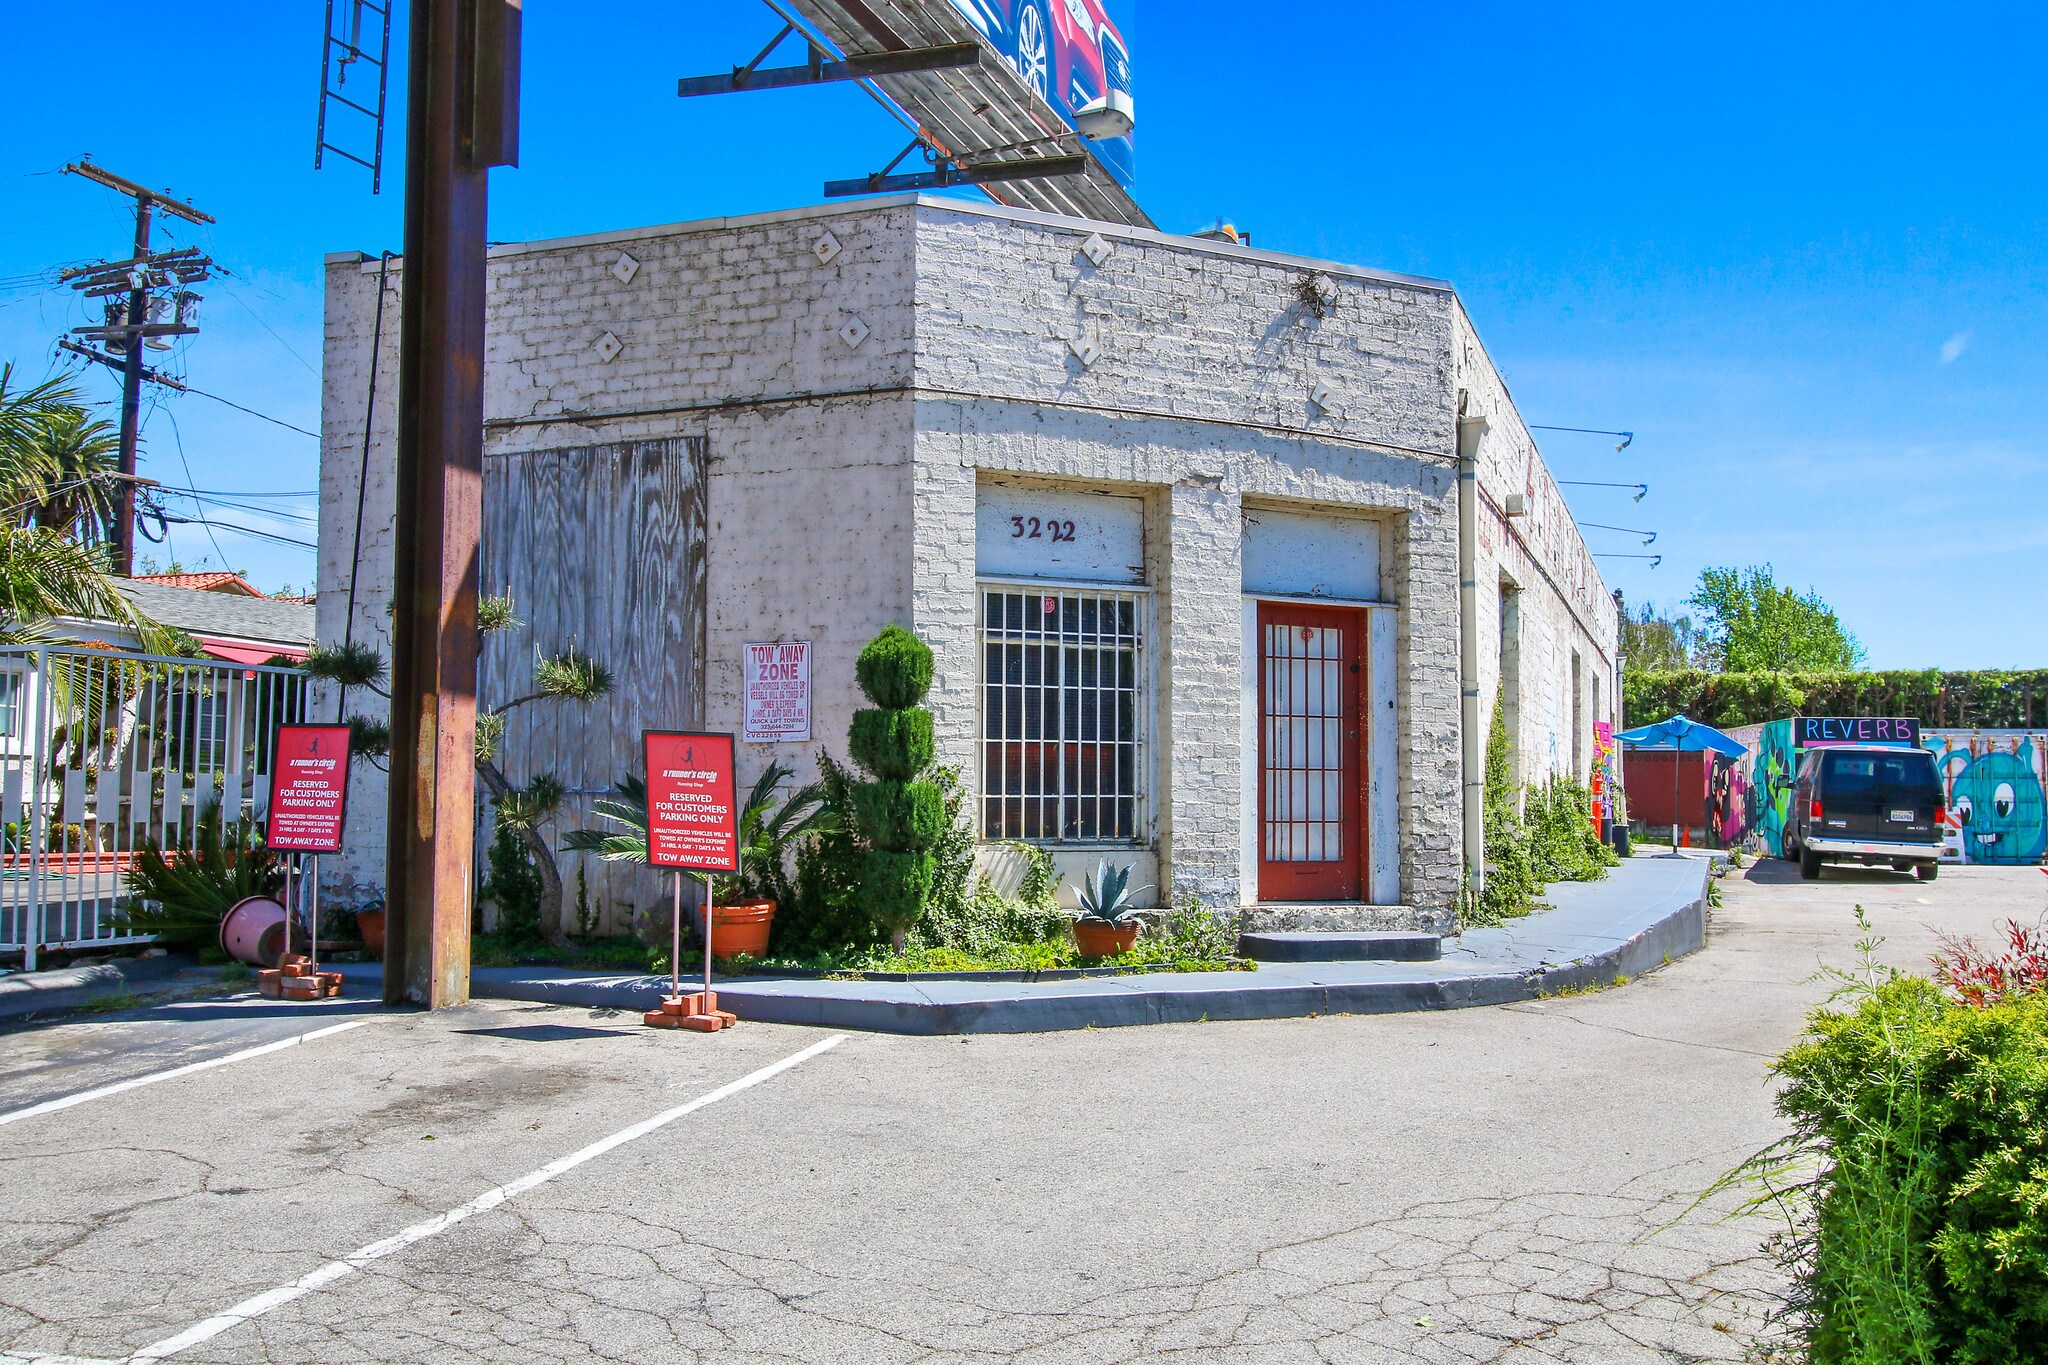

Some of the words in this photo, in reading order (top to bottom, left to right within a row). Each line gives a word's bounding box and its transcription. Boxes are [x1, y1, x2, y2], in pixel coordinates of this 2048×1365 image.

[1011, 516, 1076, 542] 3222
[751, 646, 774, 664] TOW
[780, 645, 805, 663] AWAY
[759, 663, 798, 681] ZONE
[751, 682, 779, 690] UNAUTHORIZED
[781, 681, 798, 690] VEHICLES
[751, 691, 767, 700] VESSELS
[769, 691, 778, 699] WILL
[786, 690, 798, 699] TOWED
[780, 700, 796, 708] EXPENSE
[1806, 719, 1912, 739] REVERB
[319, 759, 336, 767] circle
[668, 770, 697, 778] runner's
[696, 771, 717, 779] circle
[293, 780, 329, 789] RESERVED
[280, 789, 295, 797] FOR
[296, 790, 340, 798] CUSTOMERS
[670, 793, 712, 803] RESERVED
[282, 799, 314, 807] PARKING
[315, 800, 336, 808] ONLY
[656, 802, 673, 811] FOR
[675, 803, 727, 814] CUSTOMERS
[660, 812, 698, 822] PARKING
[700, 814, 724, 824] ONLY
[275, 836, 292, 844] TOW
[314, 838, 335, 846] ZONE
[657, 852, 678, 862] TOW
[679, 854, 704, 864] AWAY
[705, 856, 730, 866] ZONE
